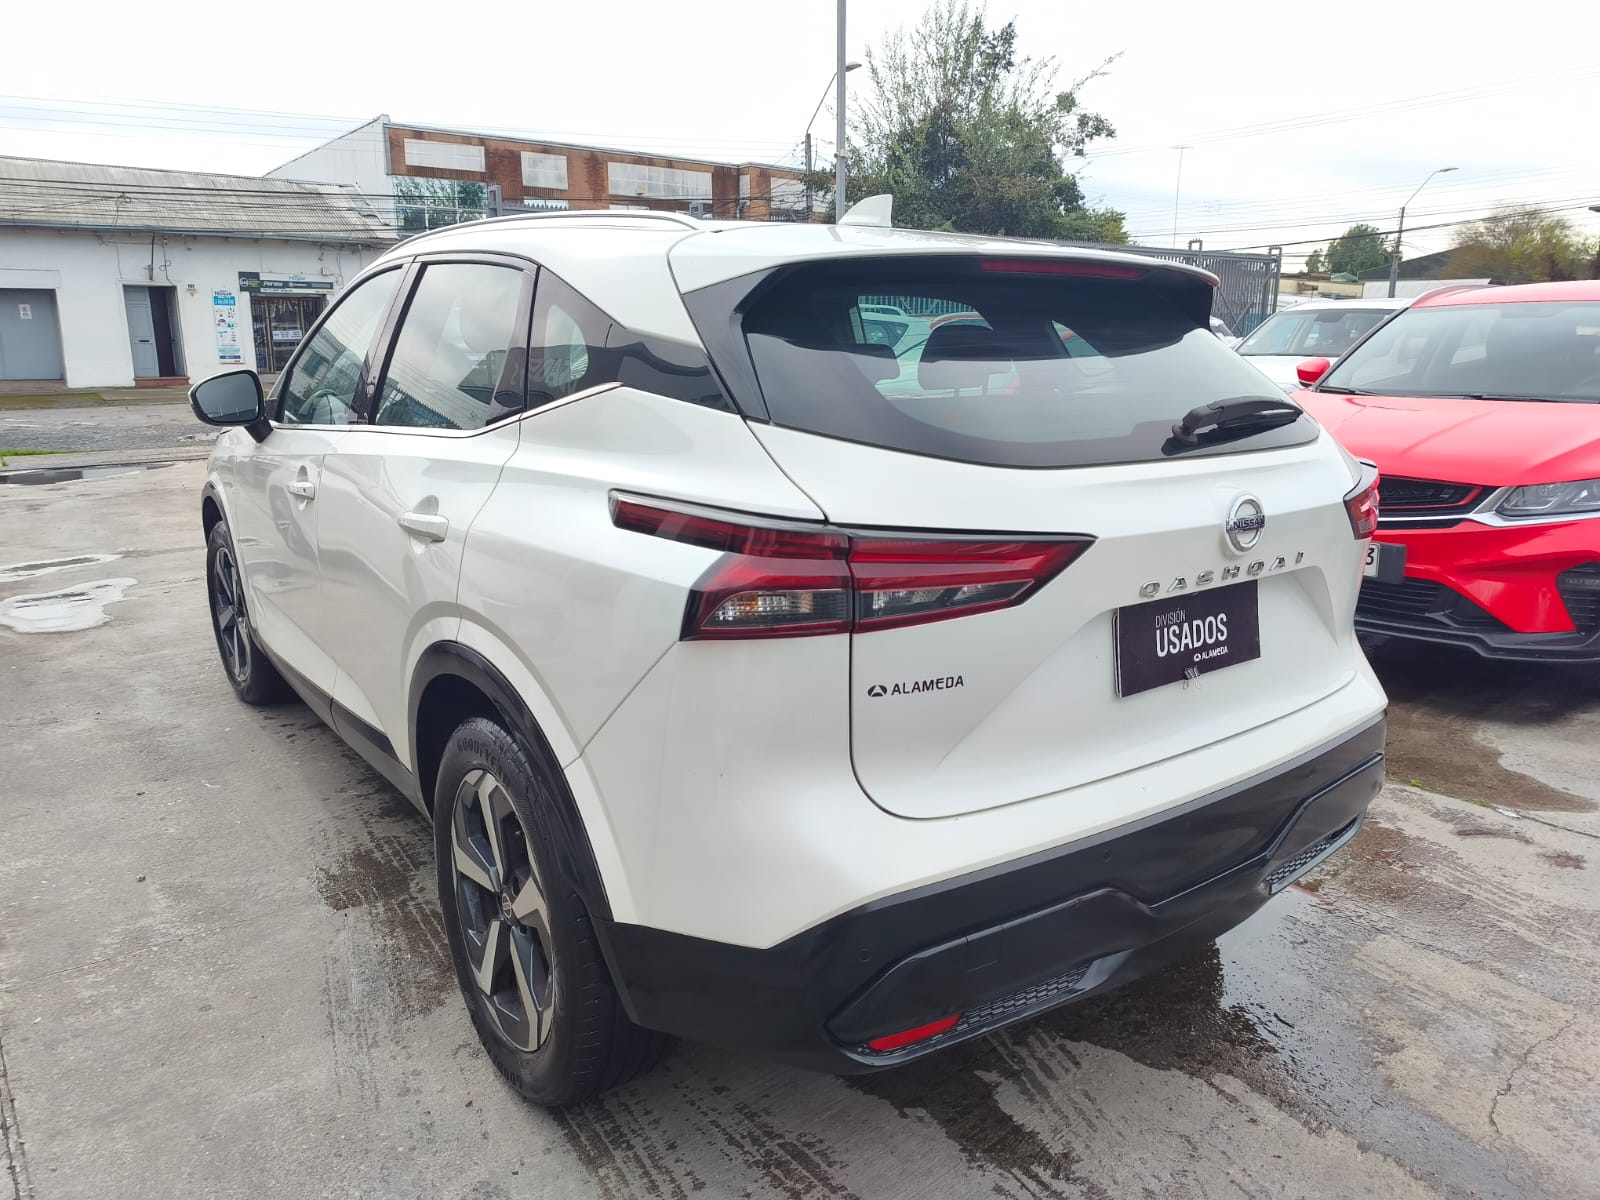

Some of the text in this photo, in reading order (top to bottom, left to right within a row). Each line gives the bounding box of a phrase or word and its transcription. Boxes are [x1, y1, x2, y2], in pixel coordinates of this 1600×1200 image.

[1232, 516, 1265, 531] NISSAN
[1139, 552, 1304, 598] QASHQAI
[1155, 608, 1186, 627] DIVISIÓN
[1155, 613, 1228, 657] USADOS
[1202, 646, 1229, 660] ALAMEDA
[891, 675, 964, 696] ALAMEDA
